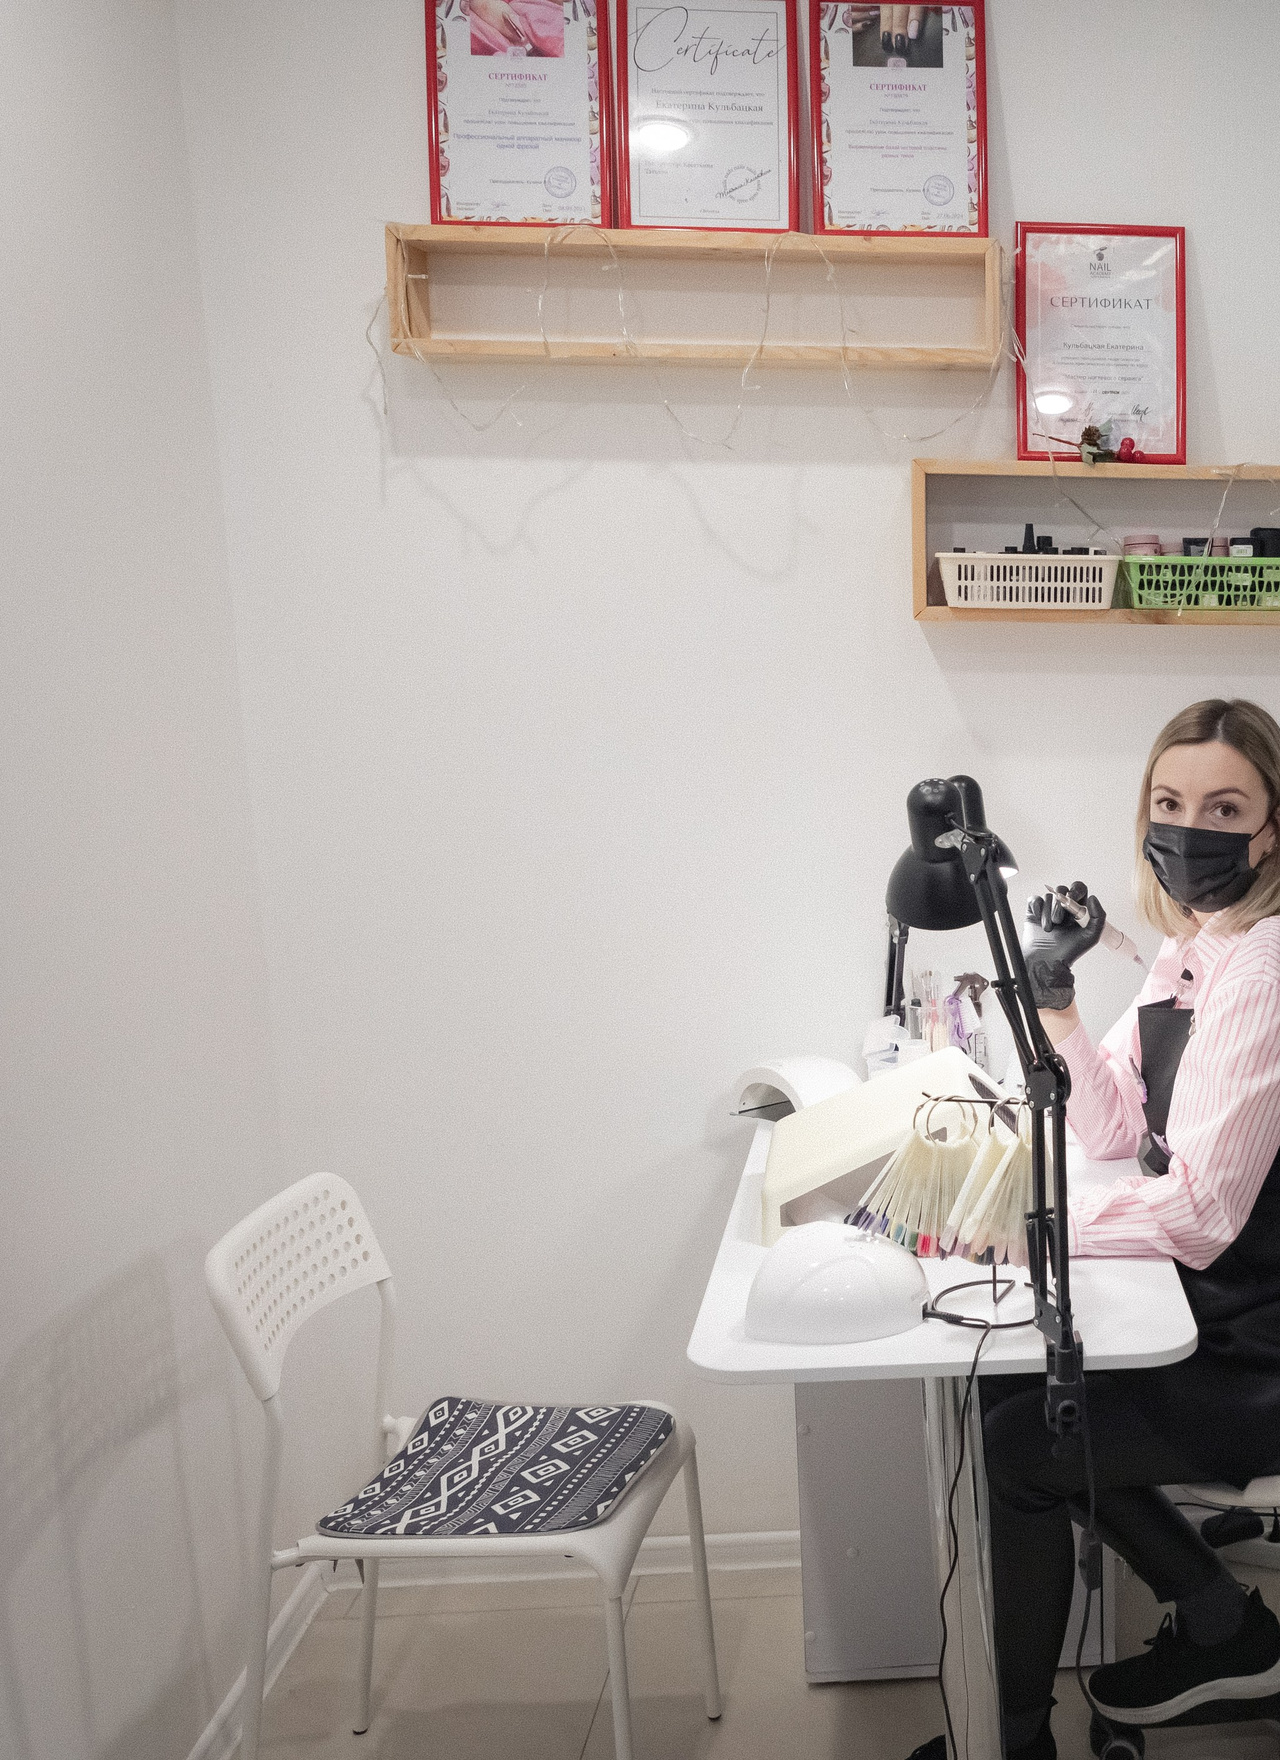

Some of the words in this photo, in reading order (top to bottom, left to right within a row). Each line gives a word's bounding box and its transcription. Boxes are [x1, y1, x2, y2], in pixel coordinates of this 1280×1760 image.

[629, 6, 787, 75] Certificate
[488, 72, 548, 81] СЕРТИФИКАТ
[869, 83, 927, 91] СЕРТИФИКАТ
[656, 100, 706, 111] Екатерина
[708, 102, 763, 113] Кульбацкая
[1089, 262, 1112, 272] NAIL
[1049, 296, 1153, 310] СЕРТИФИКАТ
[1063, 341, 1105, 350] Кульбацкая
[1106, 343, 1144, 351] Екатерина
